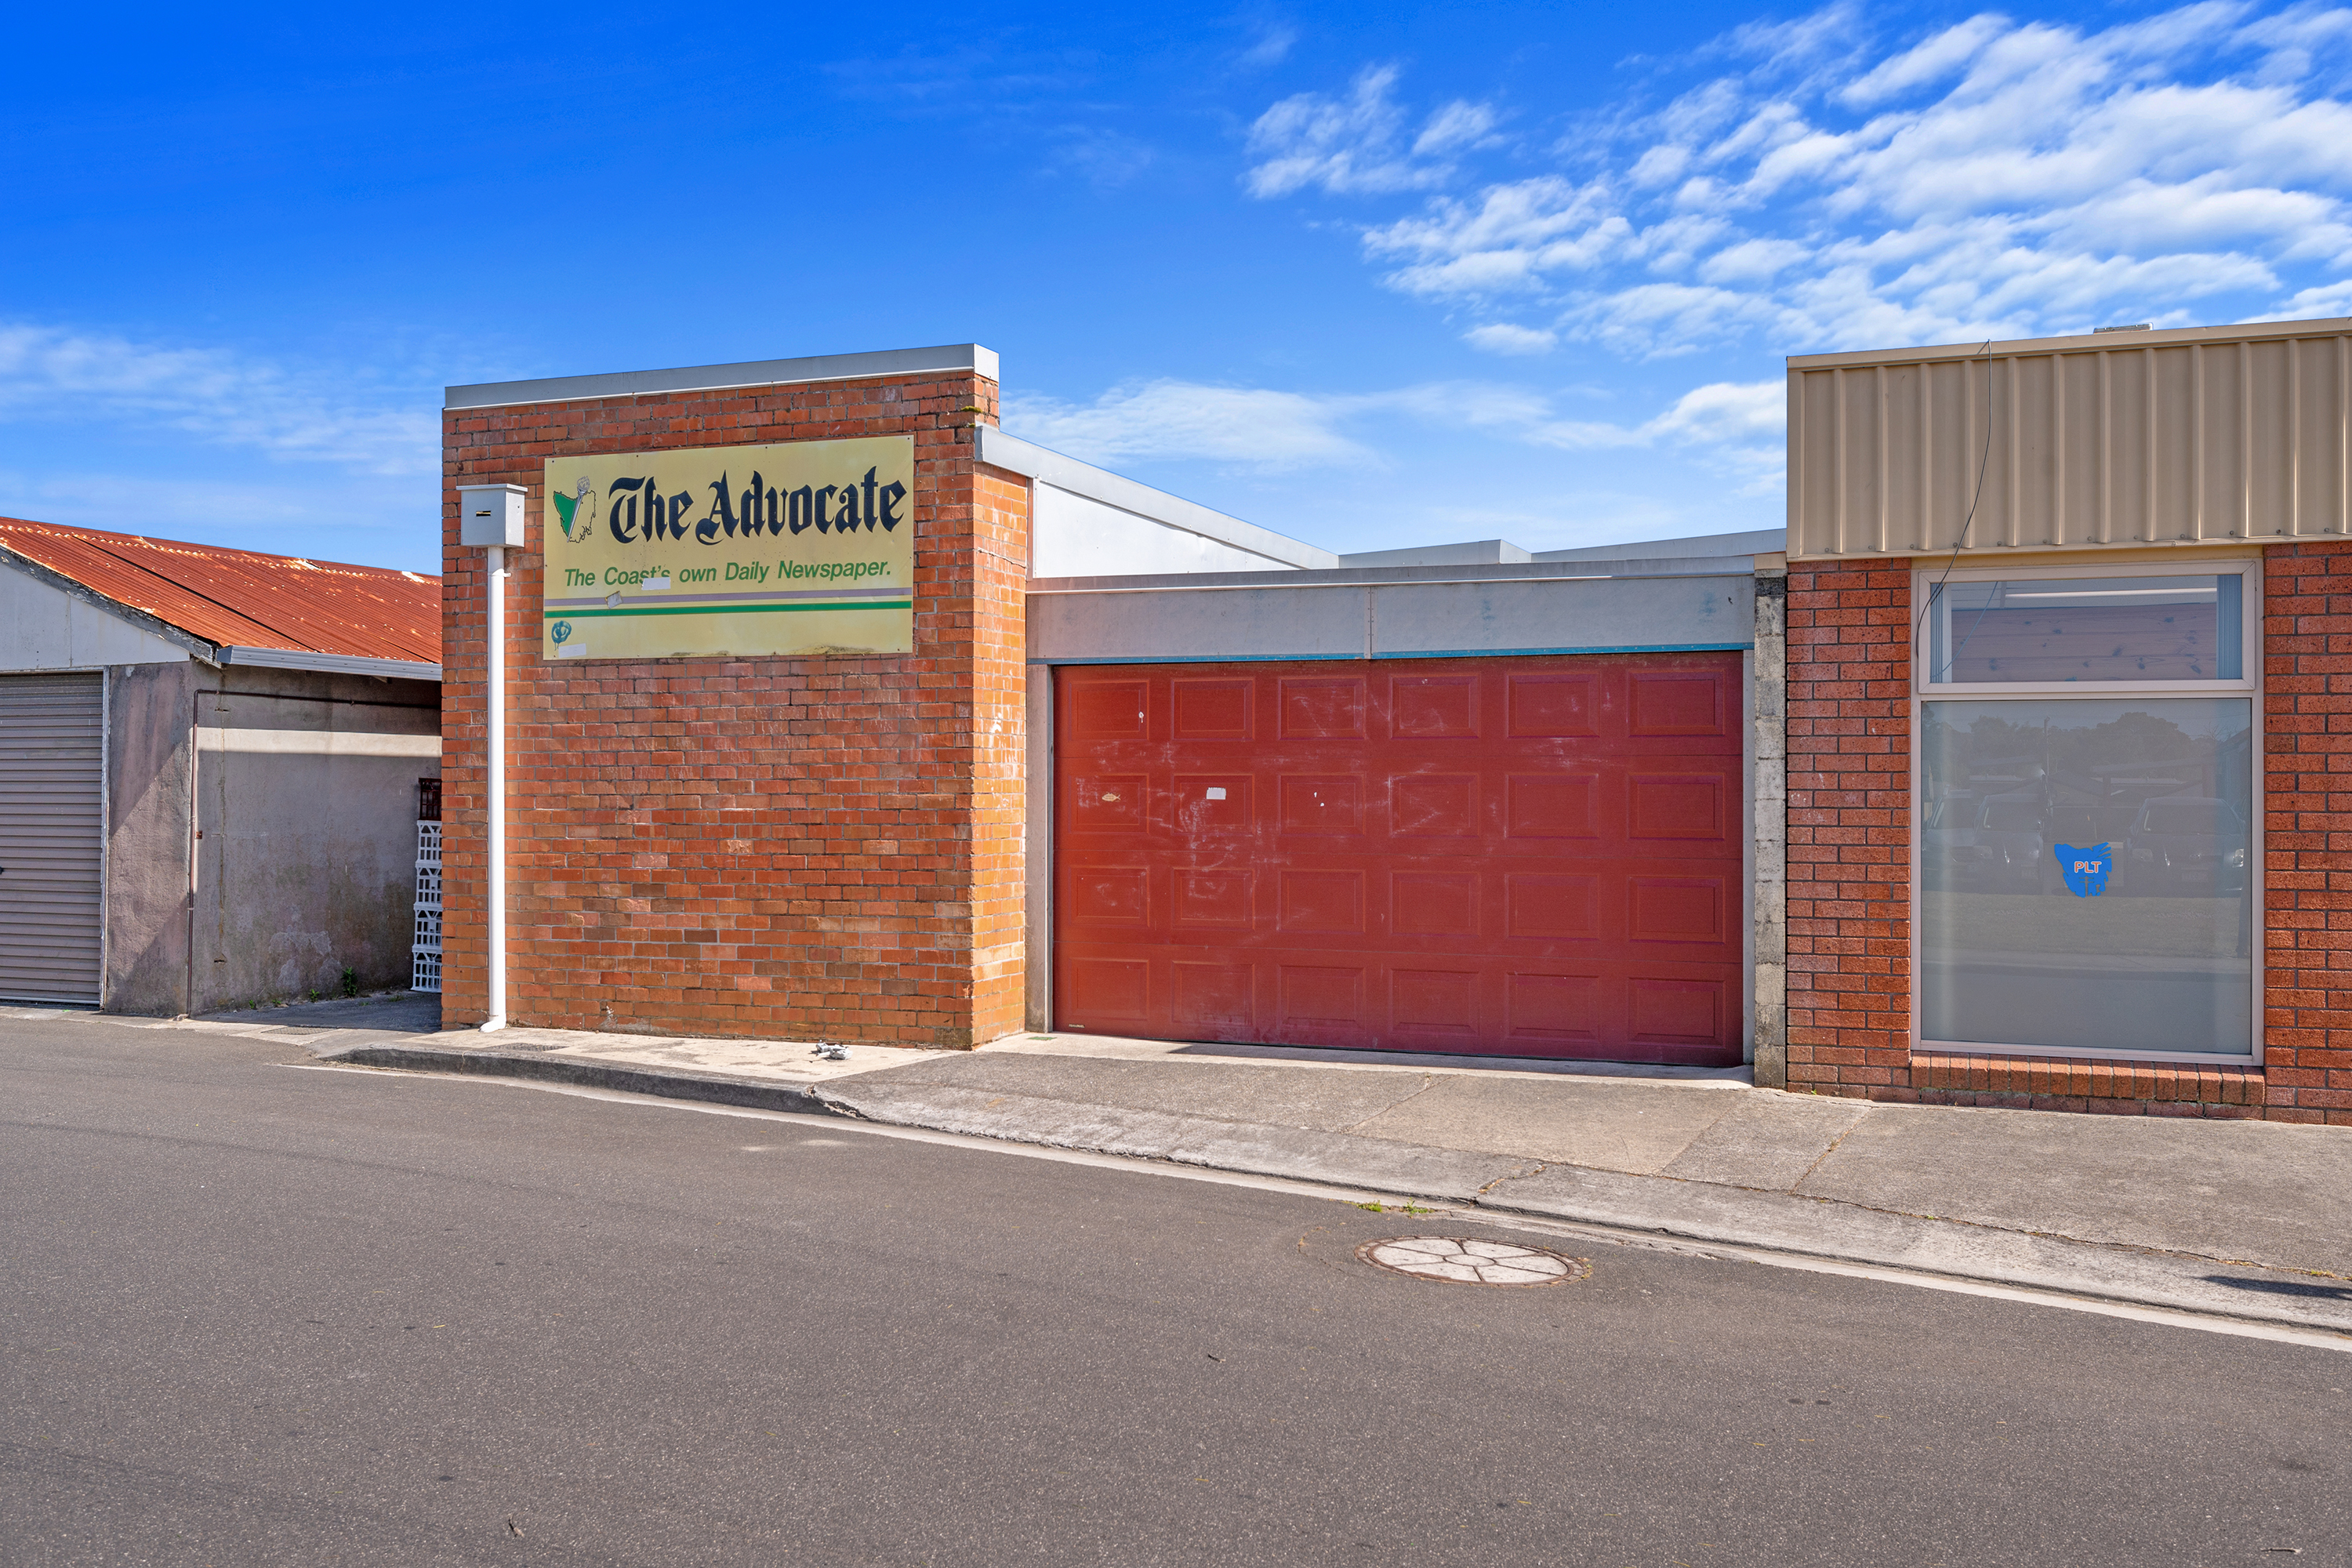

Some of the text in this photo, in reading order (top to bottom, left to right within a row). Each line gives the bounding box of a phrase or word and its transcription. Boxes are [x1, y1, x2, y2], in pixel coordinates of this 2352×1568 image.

[608, 465, 908, 546] The Advocate
[564, 568, 596, 586] The
[679, 567, 717, 583] own
[724, 561, 770, 583] Daily
[777, 560, 891, 582] Newspaper.
[2074, 861, 2102, 873] PLT
